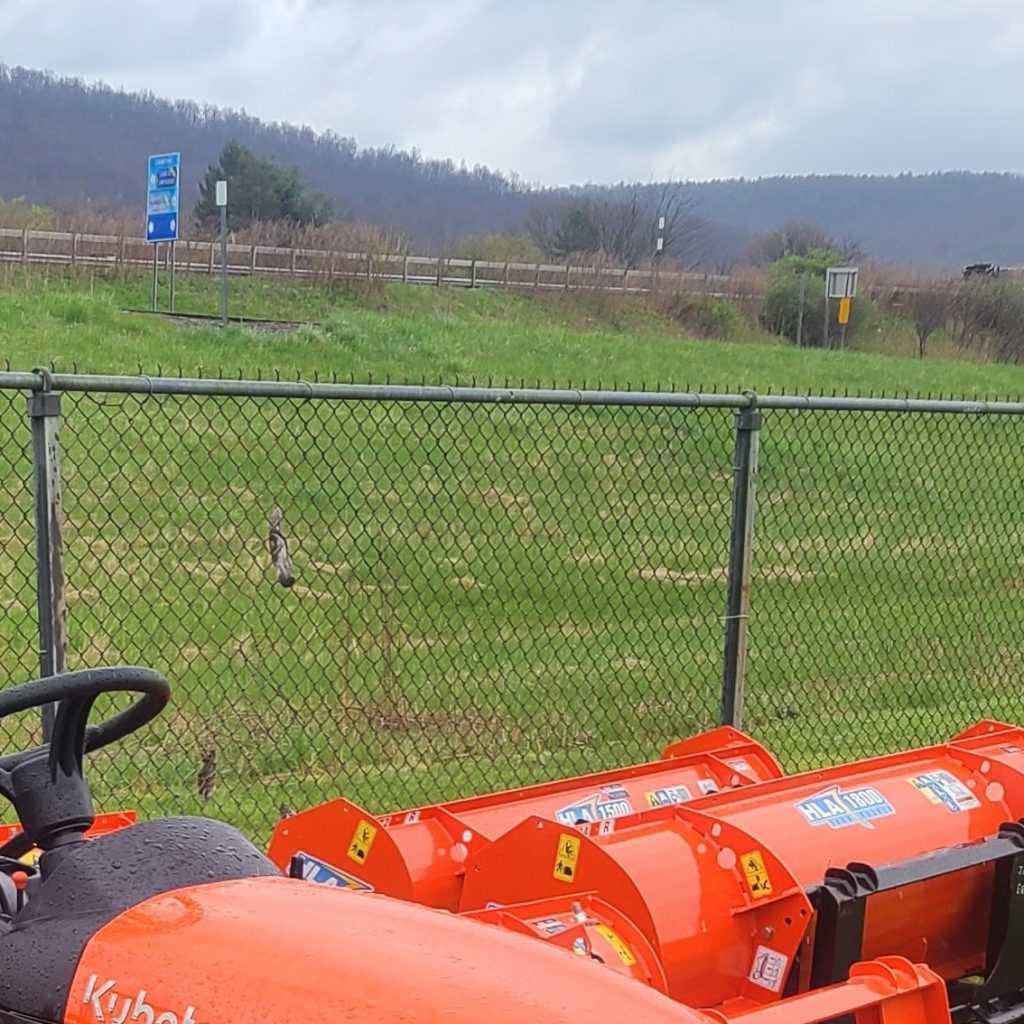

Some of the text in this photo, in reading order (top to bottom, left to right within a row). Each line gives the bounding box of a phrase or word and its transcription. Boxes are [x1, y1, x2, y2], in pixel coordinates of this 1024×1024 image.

[598, 801, 629, 820] 1500
[798, 798, 844, 821] HLA
[842, 788, 884, 810] 1800
